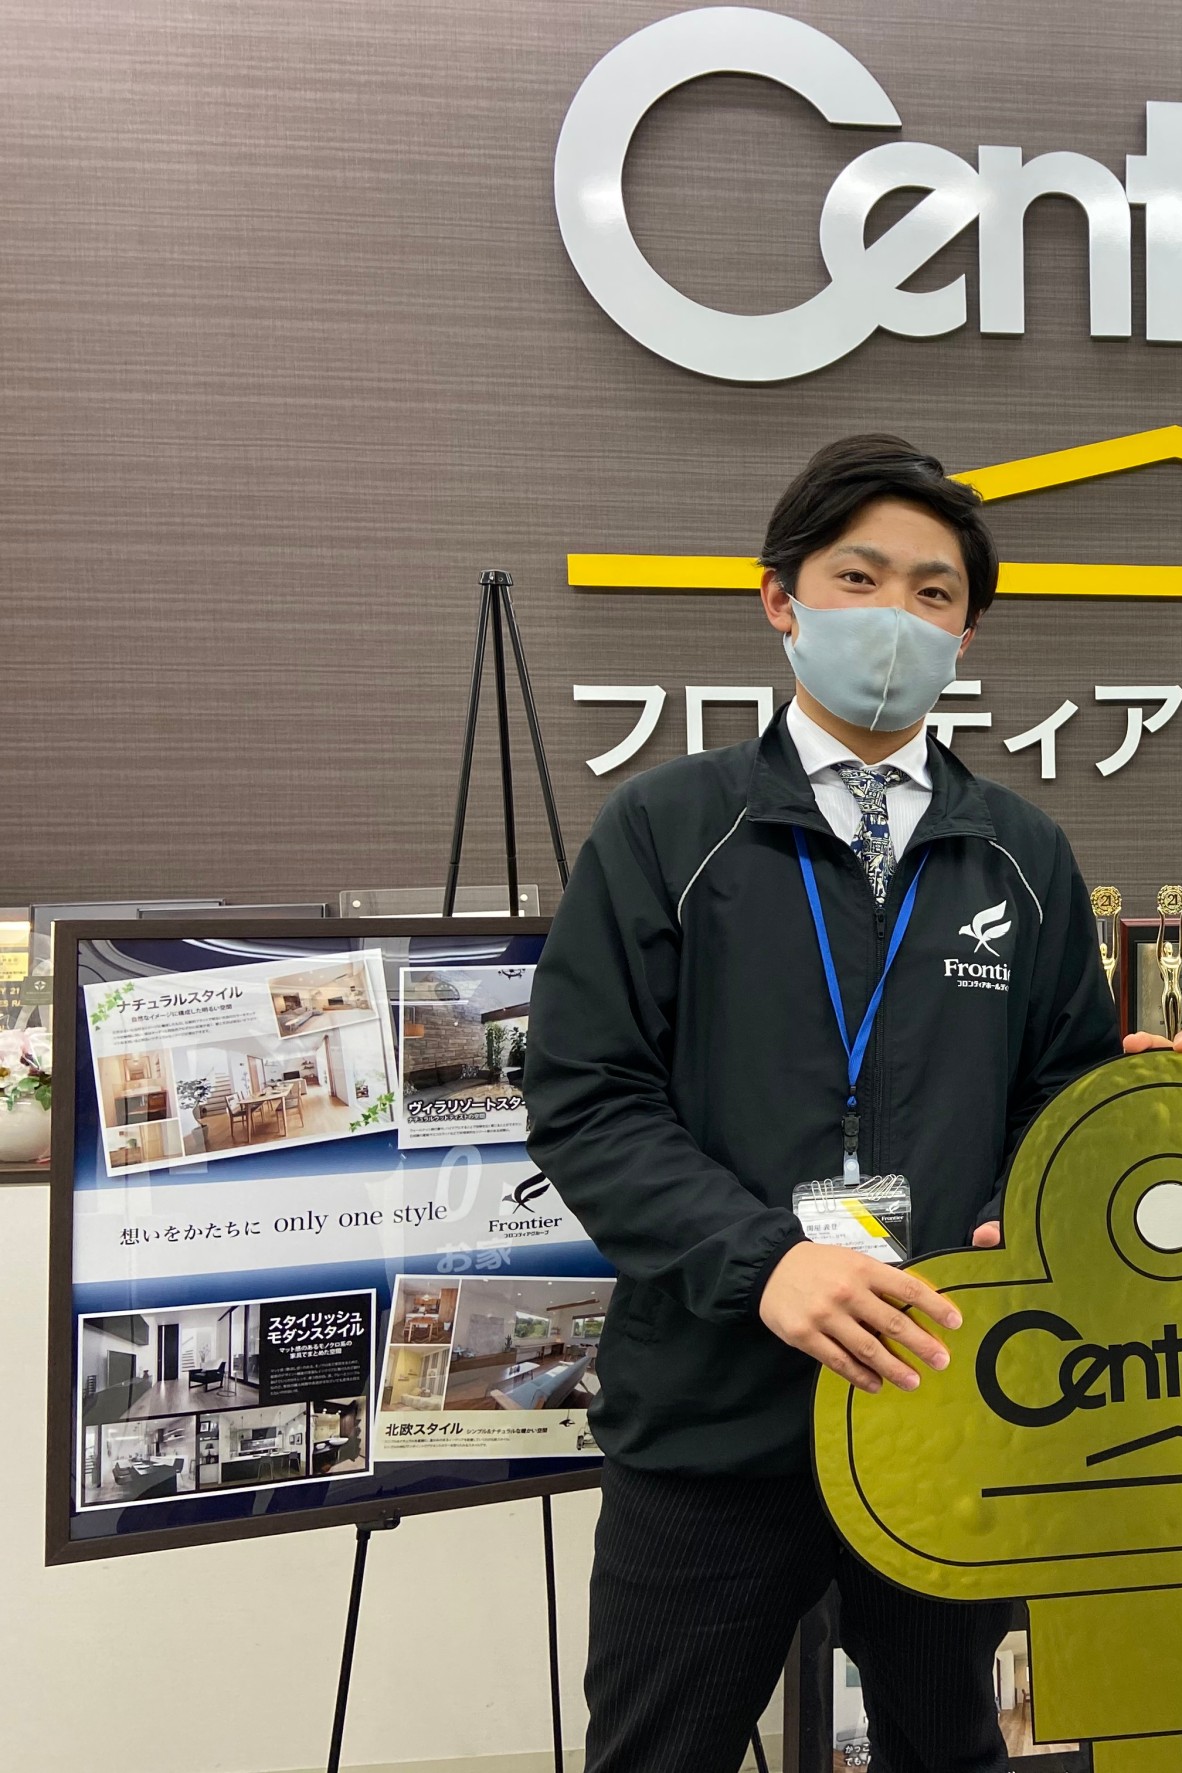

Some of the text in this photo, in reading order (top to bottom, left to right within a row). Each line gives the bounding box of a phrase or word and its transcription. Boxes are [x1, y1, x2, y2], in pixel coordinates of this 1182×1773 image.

[1100, 894, 1113, 907] 21
[1166, 894, 1179, 907] 21
[943, 958, 1011, 981] Fronti
[117, 986, 243, 1014] ナチュラルスタイル
[408, 1096, 526, 1116] ヴィラリゾートスタ
[119, 1201, 448, 1247] 想いをかたちに only one style
[488, 1216, 563, 1233] Frontier
[503, 1229, 551, 1239] フロンティアグループ
[268, 1311, 363, 1331] スタイリッシュ
[267, 1322, 365, 1345] モダンスタイル
[385, 1422, 463, 1437] 北欧スタイル
